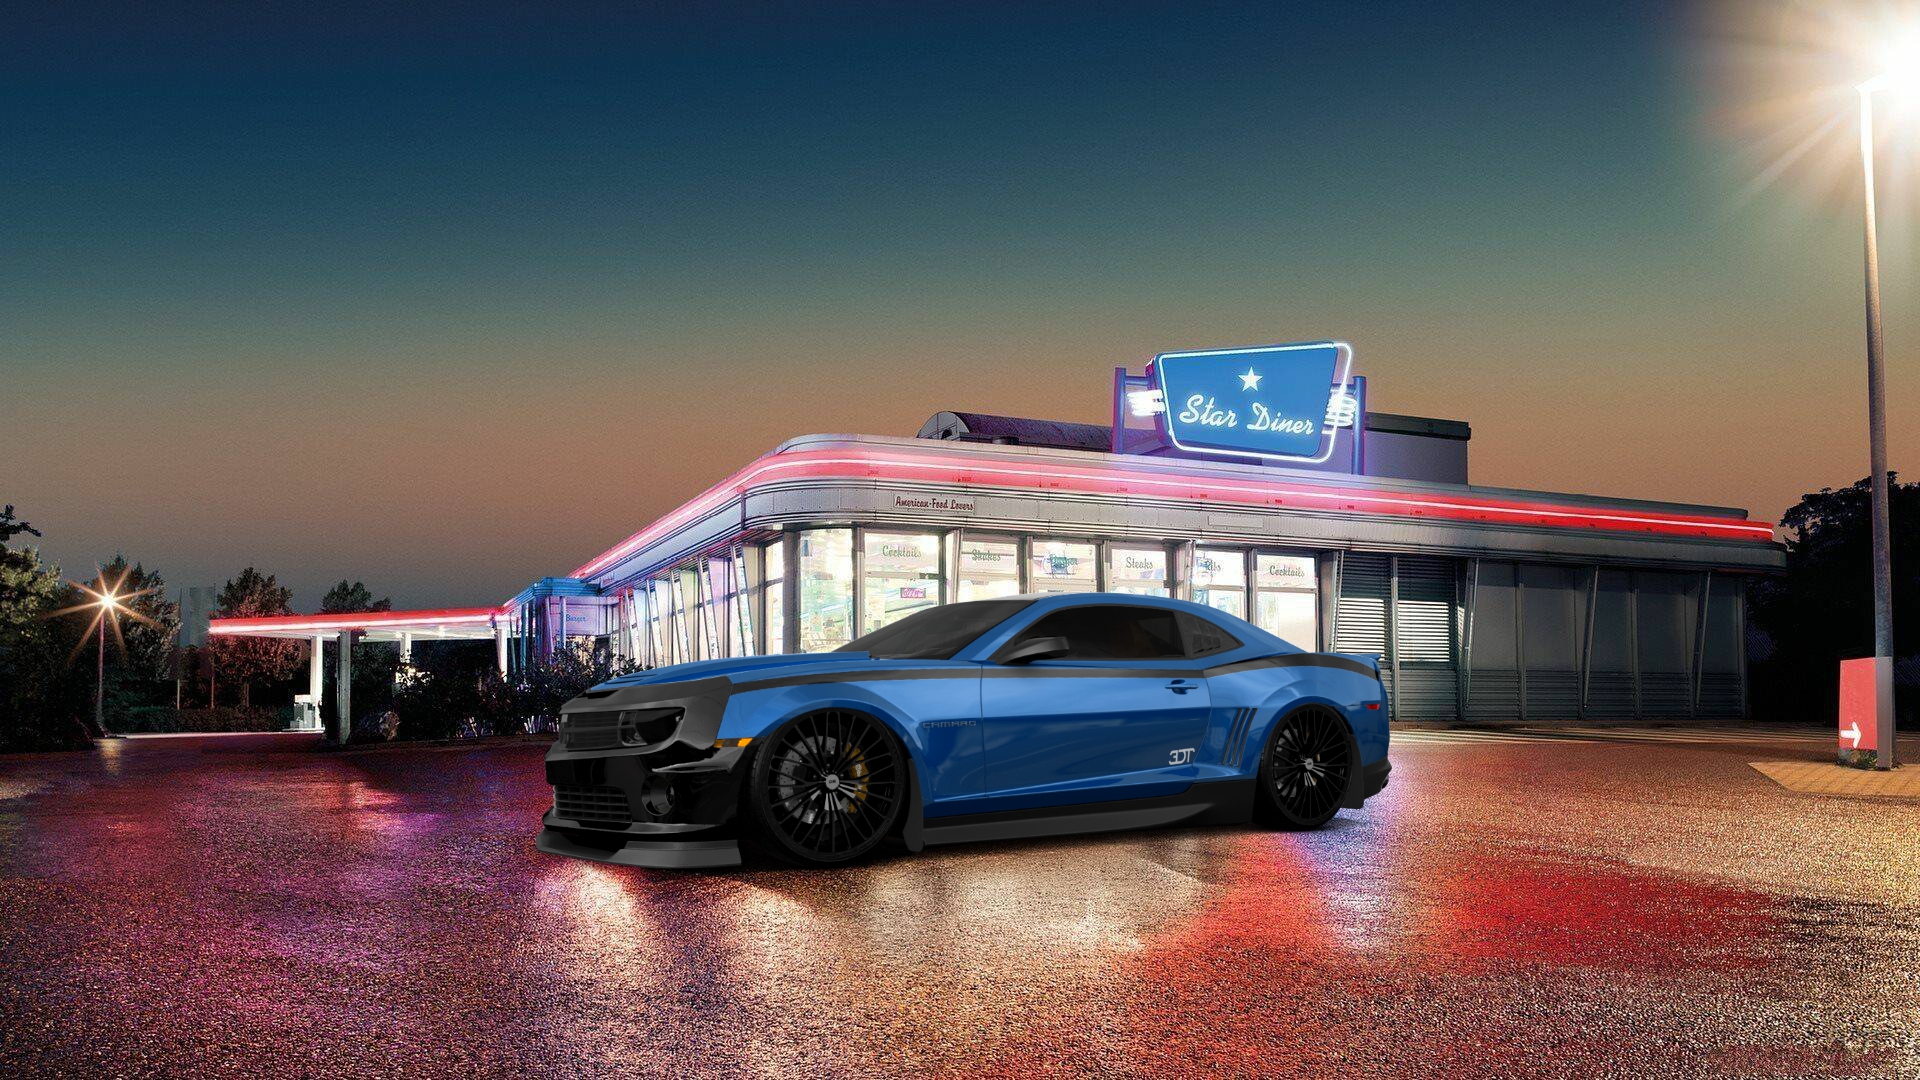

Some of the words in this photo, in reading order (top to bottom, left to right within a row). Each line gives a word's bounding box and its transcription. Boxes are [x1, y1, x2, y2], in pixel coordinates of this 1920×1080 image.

[1179, 394, 1238, 428] Star
[1246, 402, 1315, 436] Diner
[882, 544, 922, 559] Cocktails
[1125, 556, 1153, 570] Steaks
[1269, 565, 1305, 578] Cocktails
[922, 720, 977, 729] CAMARO
